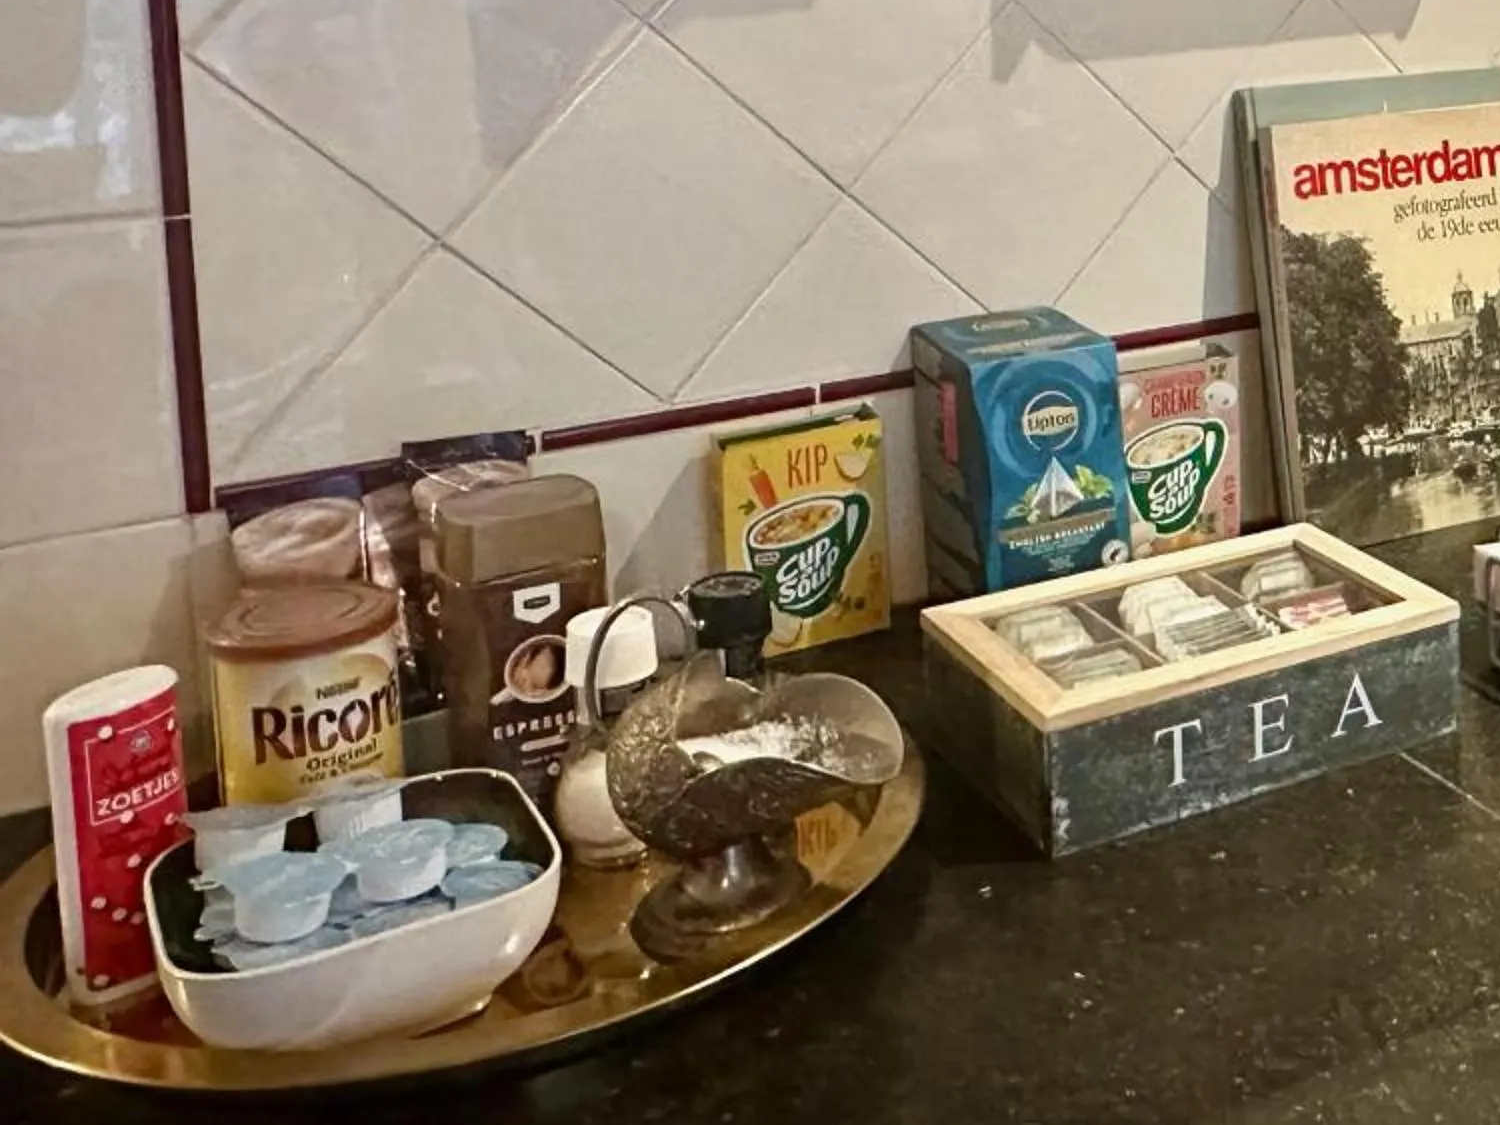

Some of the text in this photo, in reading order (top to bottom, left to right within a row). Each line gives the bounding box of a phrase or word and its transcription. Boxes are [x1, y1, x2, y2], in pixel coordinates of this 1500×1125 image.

[1393, 189, 1498, 223] gefotografeerd
[1416, 222, 1436, 241] de
[1441, 216, 1475, 239] 19de
[1027, 412, 1075, 432] Lipton
[786, 442, 828, 489] KIP
[1153, 671, 1383, 788] TEA
[306, 737, 378, 772] Original
[96, 767, 182, 818] ZOETJES
